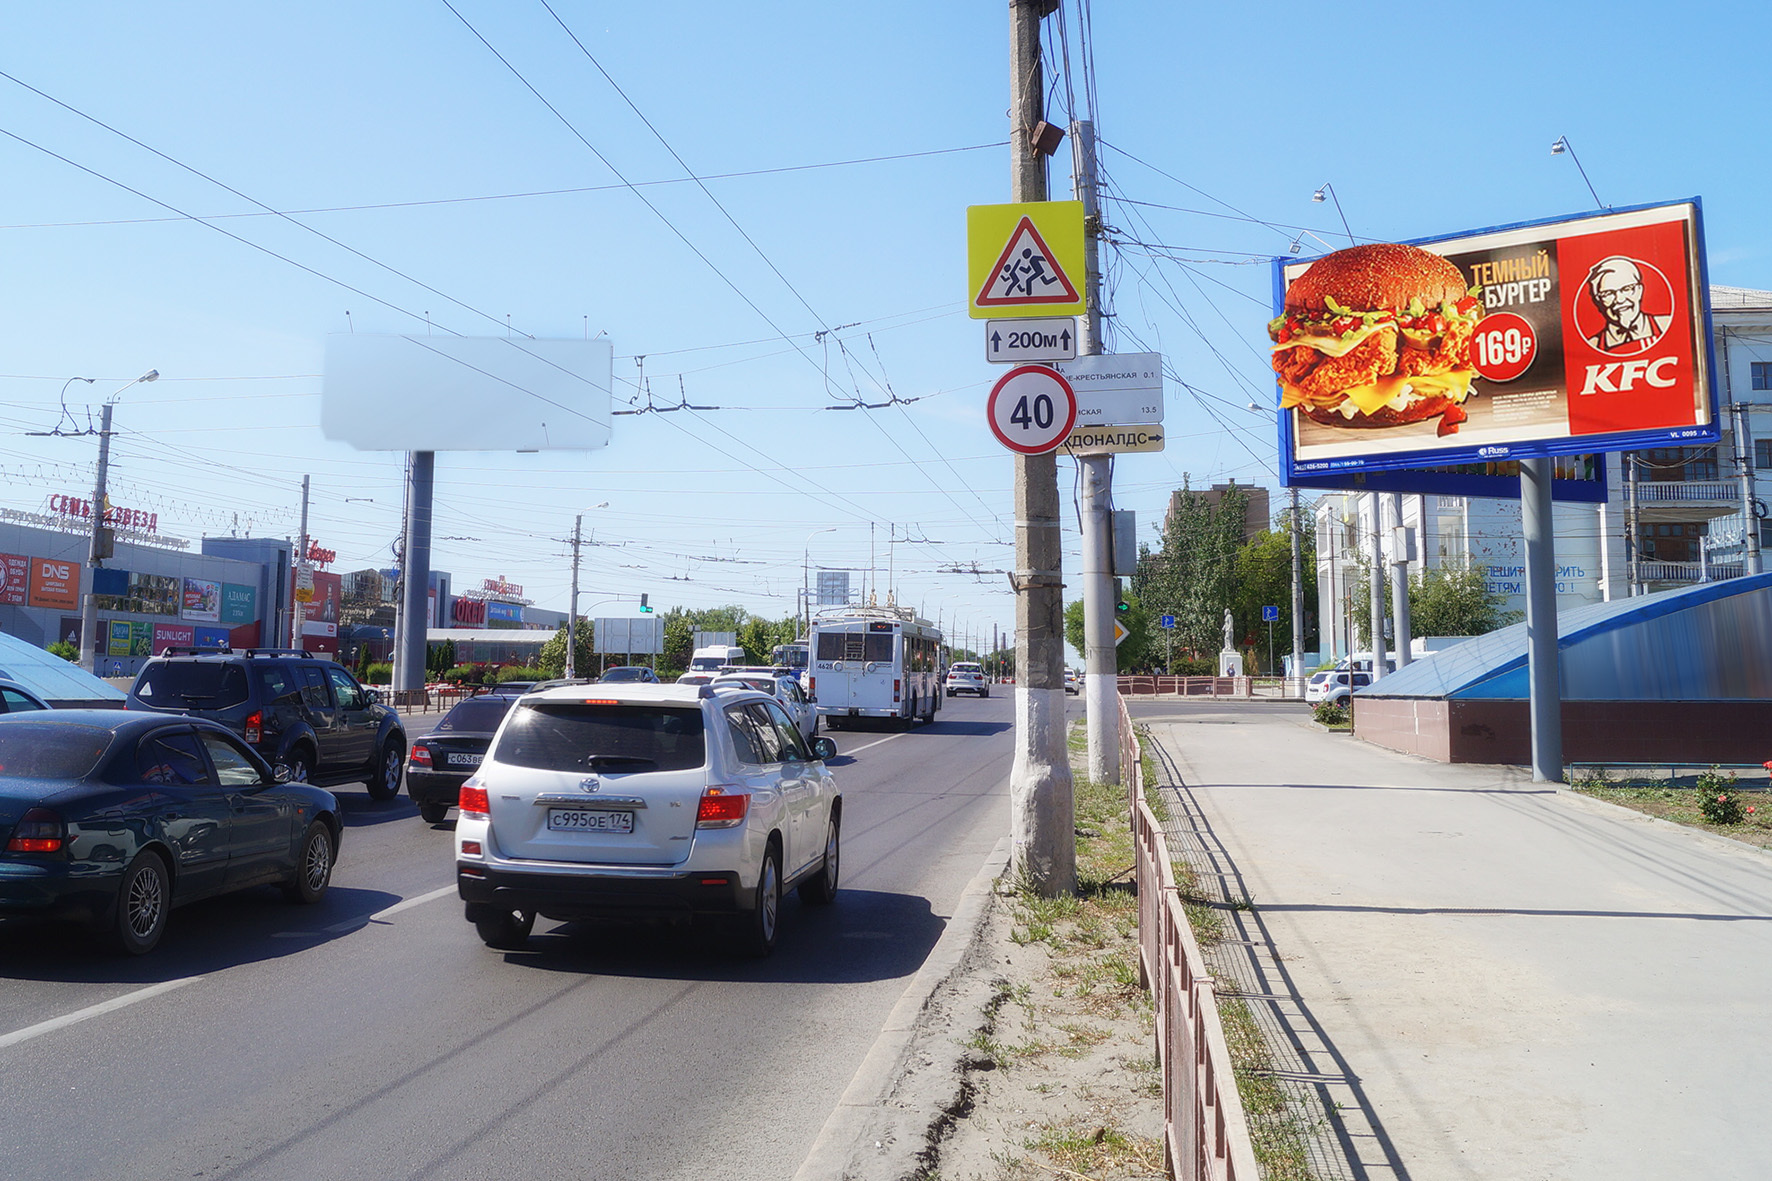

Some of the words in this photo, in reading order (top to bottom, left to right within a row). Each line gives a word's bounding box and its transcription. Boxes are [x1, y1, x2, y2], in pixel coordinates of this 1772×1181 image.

[1471, 249, 1550, 286] ТЕМНЫЙ
[1484, 278, 1551, 309] БУРГЕР
[1065, 372, 1137, 381] Е-КРЕСТЬЯНСКАЯ
[1580, 356, 1678, 395] KFC
[1010, 394, 1053, 430] 40
[1062, 432, 1147, 448] КДОНАЛДС
[1488, 446, 1509, 455] Russ
[50, 493, 90, 517] СЕМЬ
[42, 563, 70, 580] DNS
[156, 629, 192, 641] SUNLIGHT
[818, 662, 834, 670] 4628
[608, 813, 630, 826] 174
